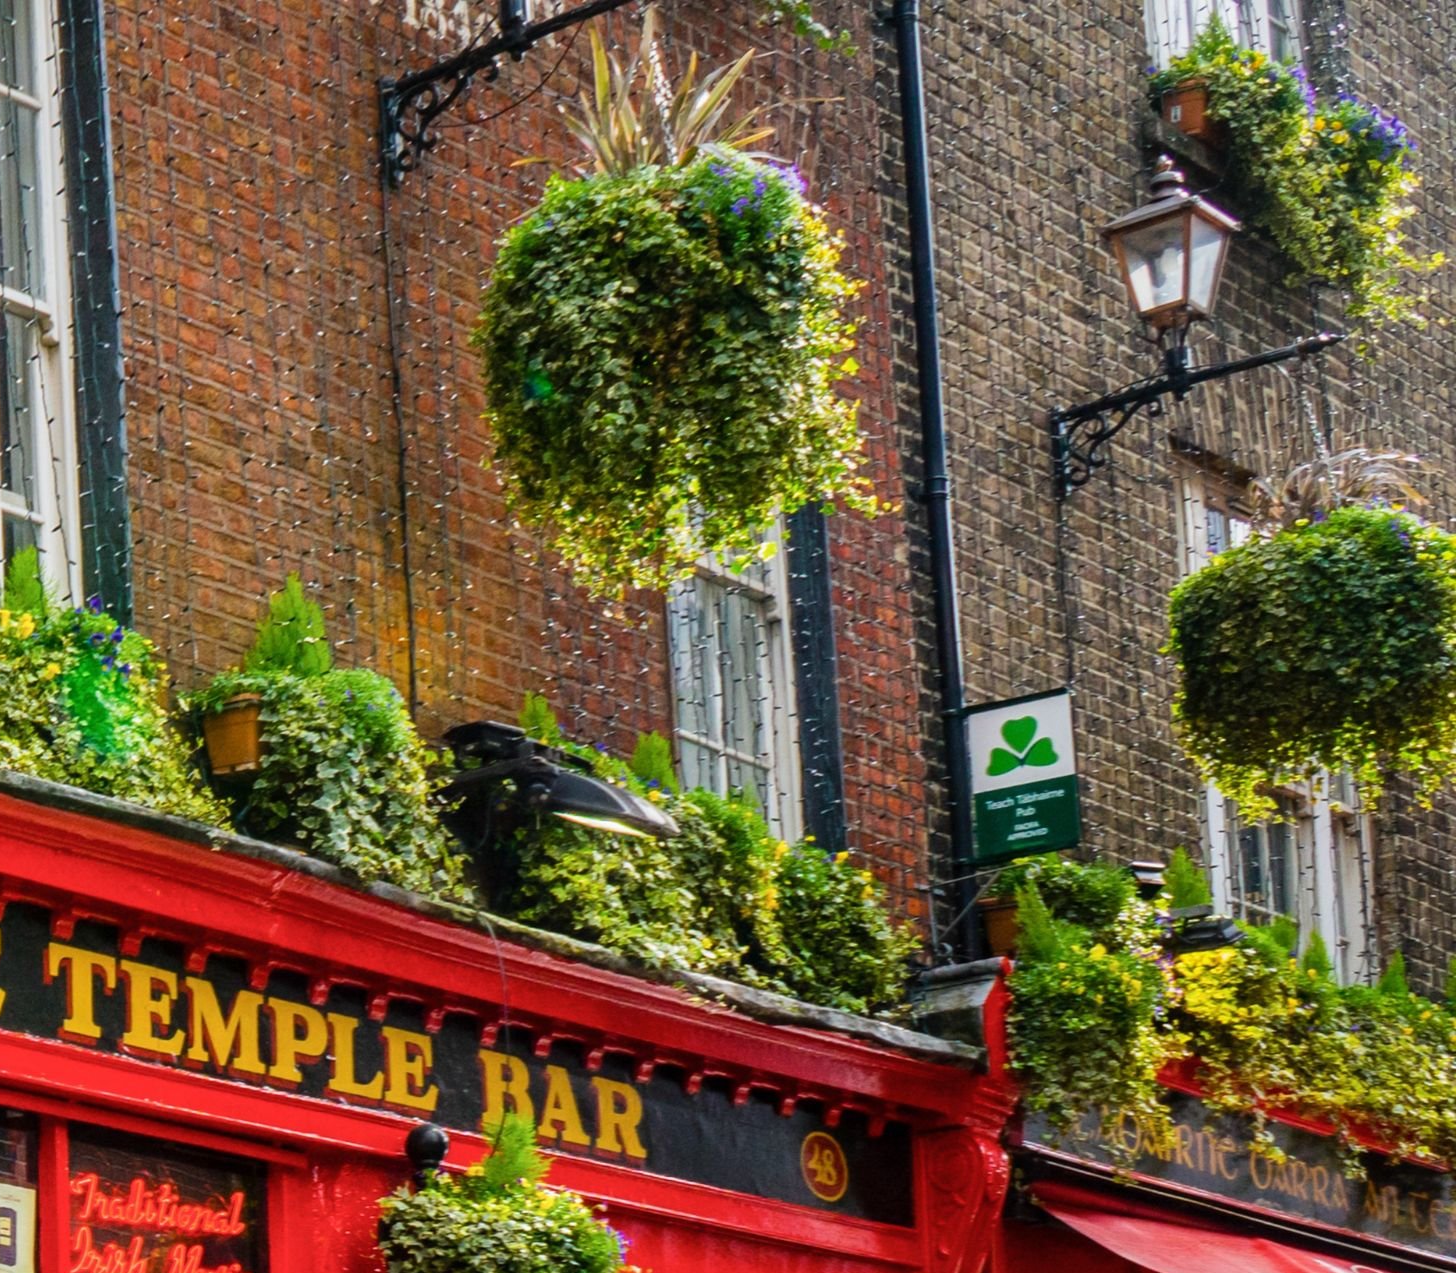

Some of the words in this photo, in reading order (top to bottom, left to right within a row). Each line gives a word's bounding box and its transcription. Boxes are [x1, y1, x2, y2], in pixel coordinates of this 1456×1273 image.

[48, 941, 441, 1111] TEMPLE
[479, 1047, 649, 1162] BAR
[807, 1143, 837, 1186] 48
[70, 1173, 246, 1236] Traditional
